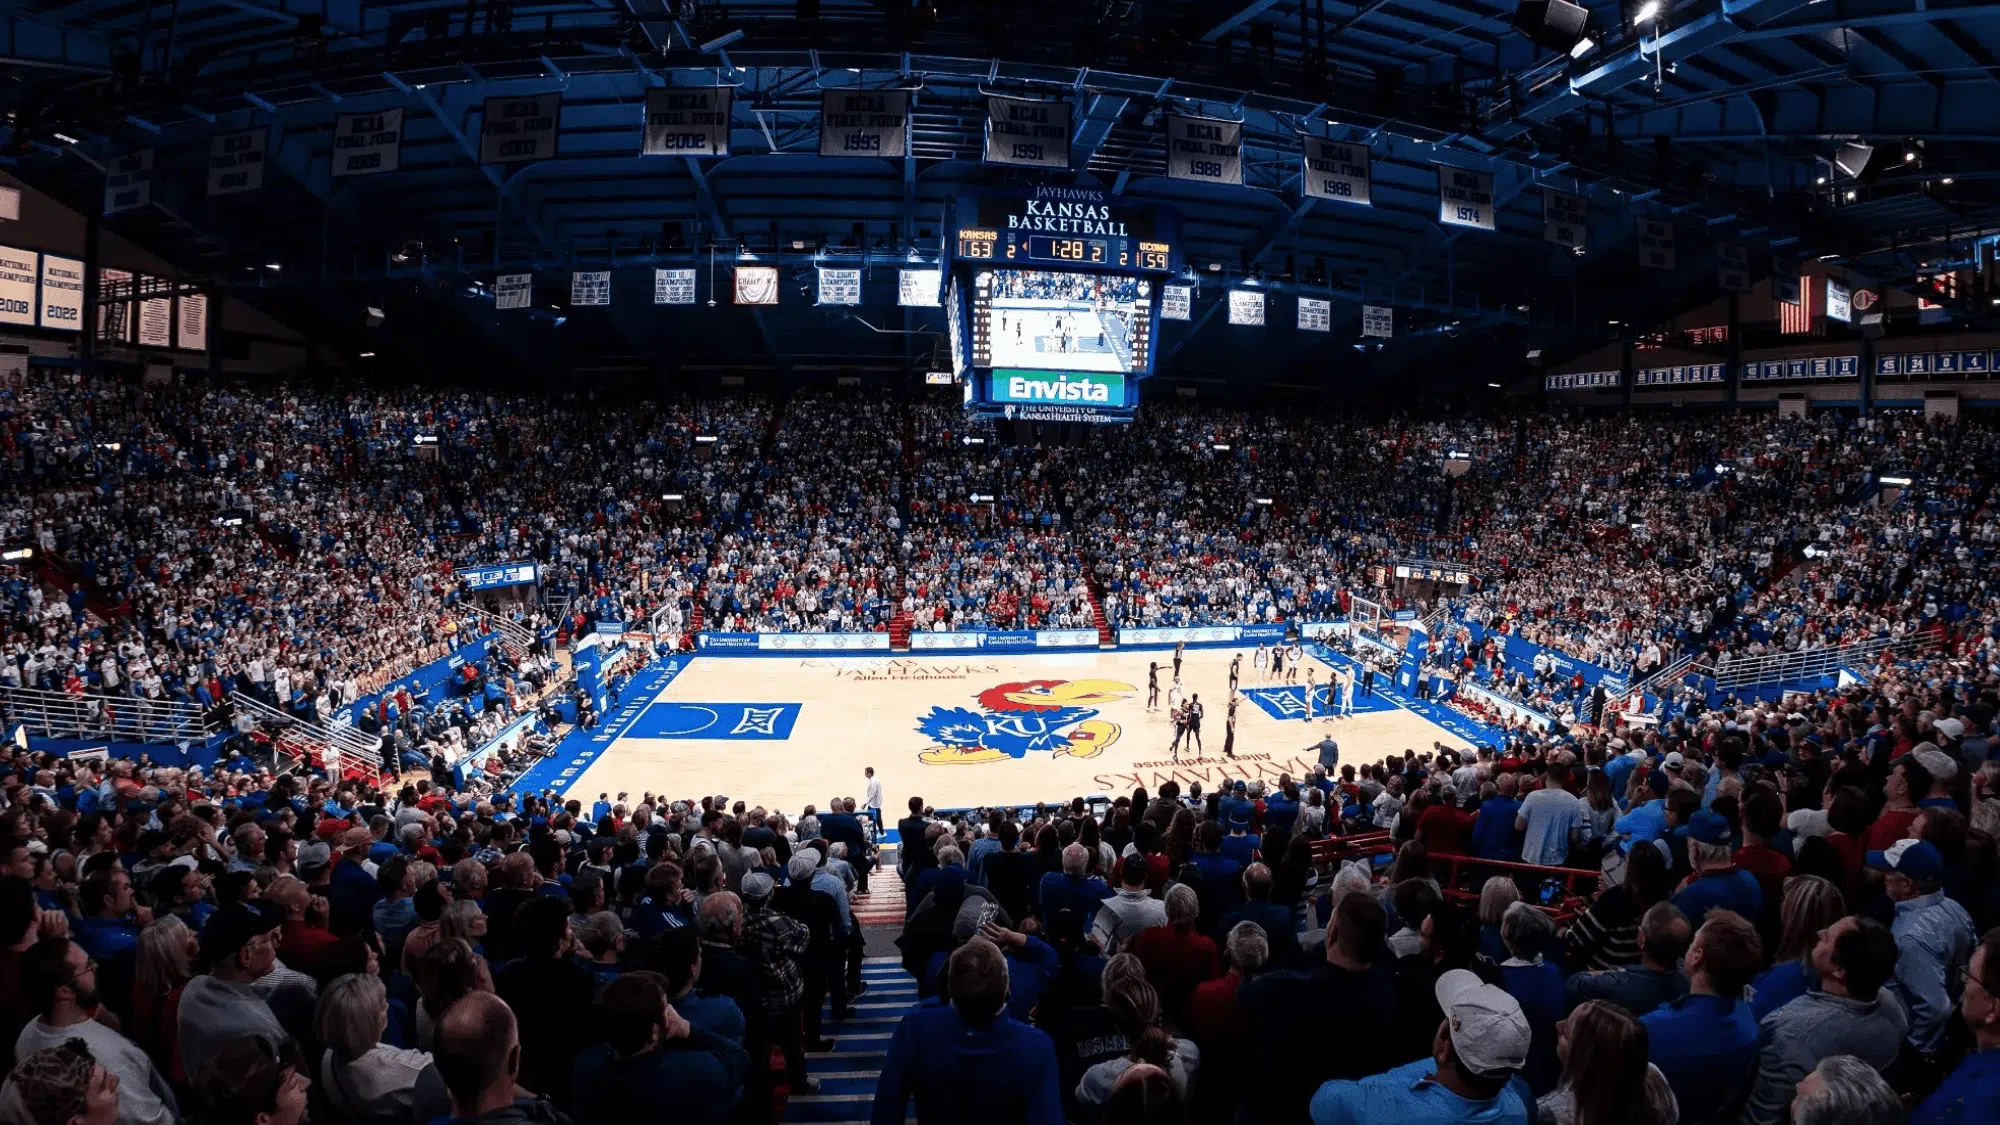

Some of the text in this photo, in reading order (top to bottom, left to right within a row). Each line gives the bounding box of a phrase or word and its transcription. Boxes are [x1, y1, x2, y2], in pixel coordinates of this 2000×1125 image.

[1187, 123, 1222, 141] NCAA
[665, 133, 706, 149] 2002
[844, 134, 881, 150] 1993
[1012, 143, 1044, 160] 1991
[1190, 160, 1222, 177] 1988
[1036, 186, 1104, 202] JAYHAWKS
[1323, 179, 1352, 196] 1986
[1026, 200, 1109, 220] KANSAS
[1457, 206, 1480, 222] 1974
[1008, 215, 1128, 237] BASKETBALL
[959, 230, 997, 241] KANSAS
[970, 242, 991, 257] 63
[1006, 245, 1016, 258] 2
[1052, 240, 1083, 259] 1:28
[1092, 247, 1101, 262] 2
[1139, 242, 1169, 253] UCONN
[1119, 252, 1128, 266] 2
[1147, 254, 1166, 268] 59
[0, 271, 36, 284] HAMPIONS
[48, 267, 81, 280] NATIONAL
[44, 278, 84, 291] CHAMPIONS
[657, 278, 694, 286] CHAMPIONS
[820, 278, 859, 286] CHAMPIONS
[0, 298, 29, 314] 2008
[47, 304, 78, 320] 2022
[1882, 360, 1895, 370] 45
[1911, 358, 1923, 369] 34
[1971, 356, 1978, 366] 4
[1009, 374, 1109, 402] Envista
[1020, 405, 1036, 413] THE
[1038, 405, 1085, 414] UNIVERSITY
[1020, 412, 1112, 424] KANSAS HEALTH SYSTEM
[835, 665, 999, 677] JAYHAWKS
[591, 696, 650, 742] Naismith
[983, 717, 1046, 738] KU
[1132, 752, 1271, 769] Allen Fieldhouse
[1093, 756, 1313, 791] JAYHAWKS
